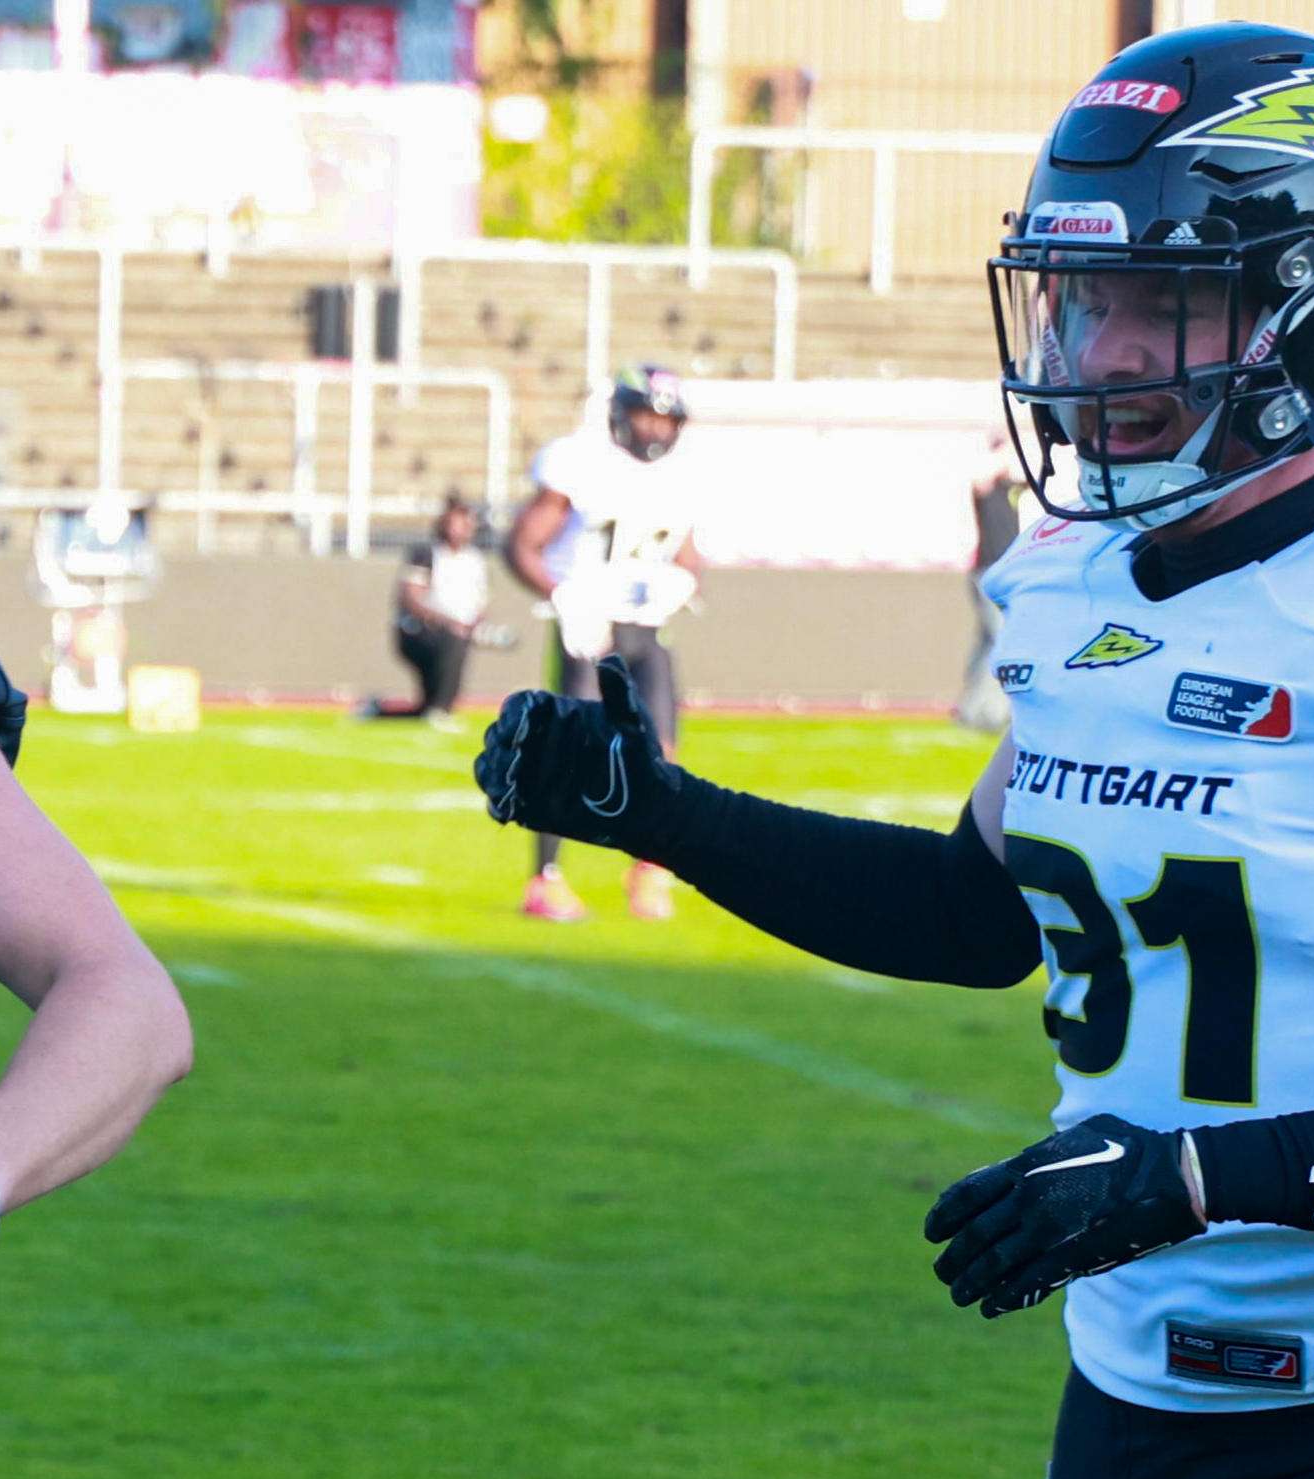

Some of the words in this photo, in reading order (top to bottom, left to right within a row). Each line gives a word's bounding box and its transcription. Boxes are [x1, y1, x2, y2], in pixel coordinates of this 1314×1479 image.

[1072, 82, 1169, 111] GAZI
[1065, 219, 1108, 233] GAZI
[1179, 678, 1234, 698] EUROPEAN
[1176, 691, 1215, 709] LEAGUE
[1173, 704, 1228, 724] FOOTBALL
[1006, 750, 1233, 815] STUTTGART
